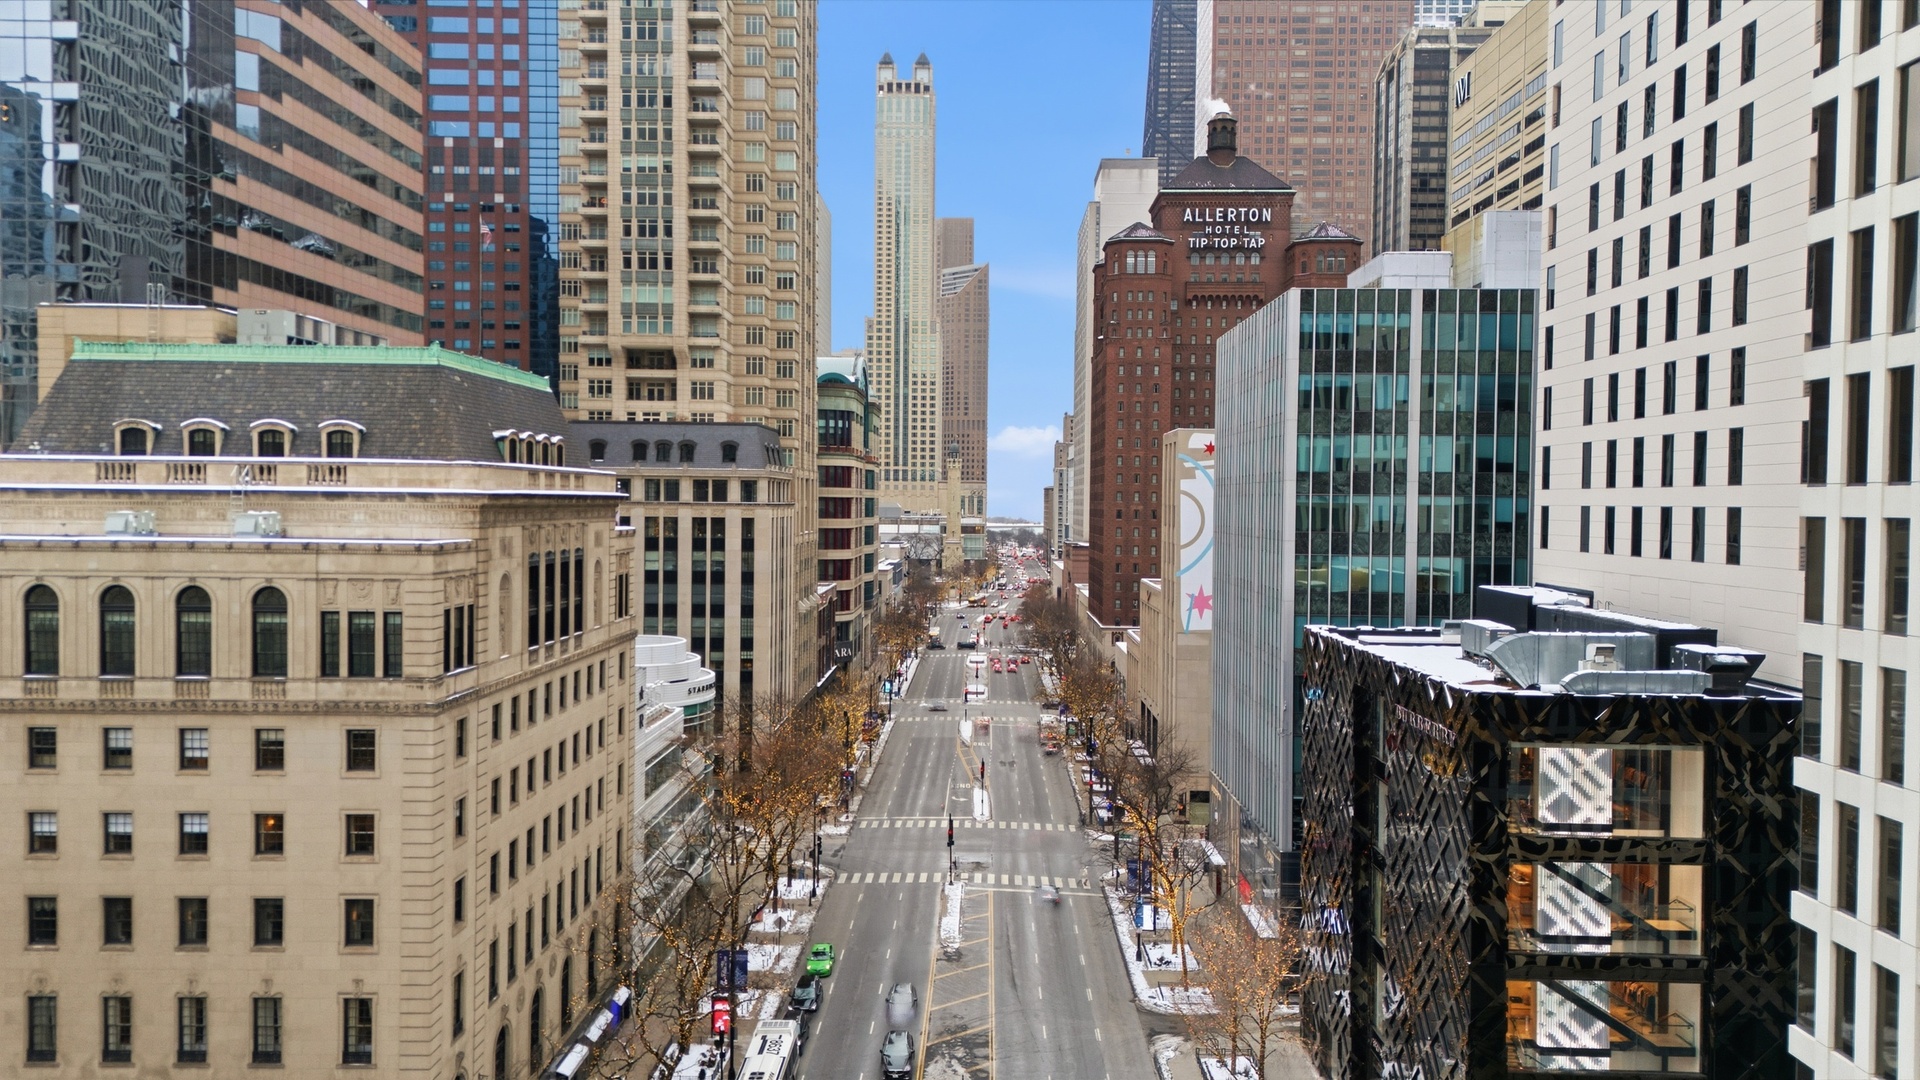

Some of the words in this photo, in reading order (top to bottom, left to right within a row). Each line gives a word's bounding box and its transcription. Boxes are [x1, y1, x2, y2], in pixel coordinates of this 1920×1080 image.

[1183, 207, 1271, 222] ALLERTON
[1205, 225, 1250, 234] HOTEL
[1395, 703, 1457, 748] BURBERRY
